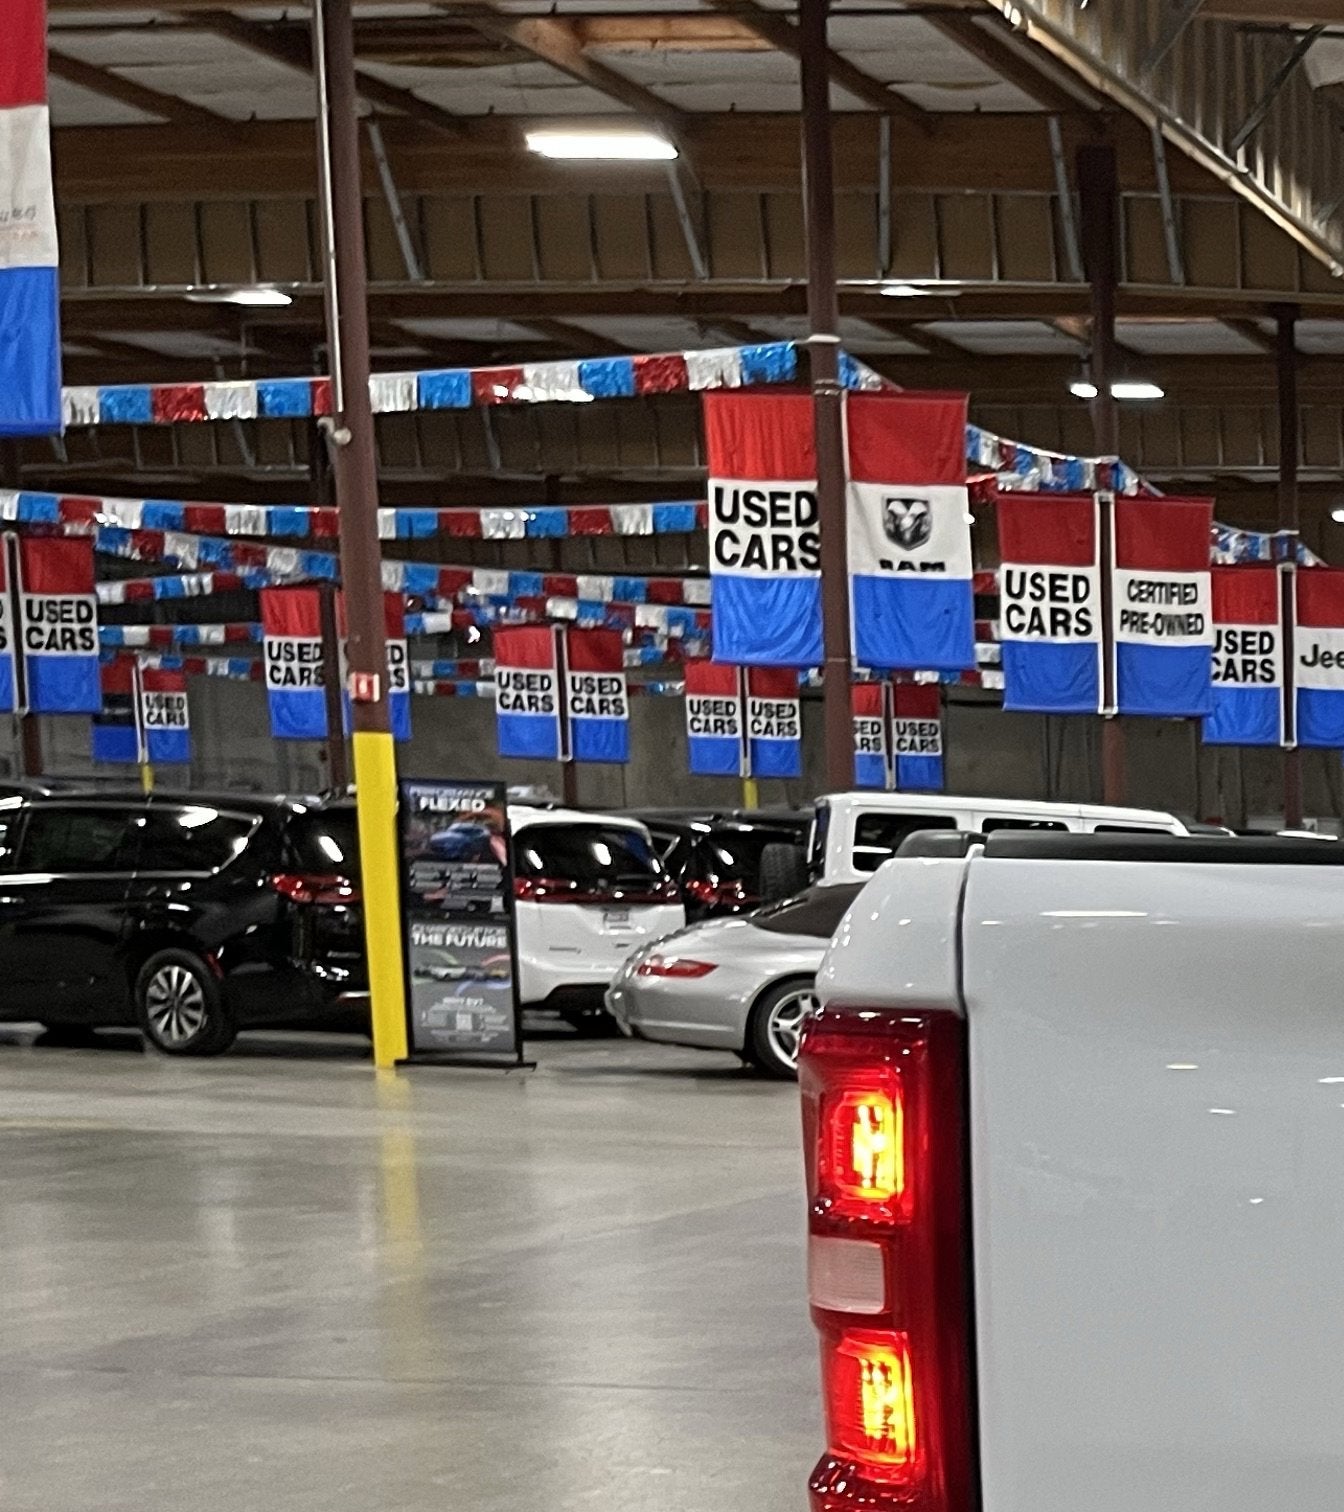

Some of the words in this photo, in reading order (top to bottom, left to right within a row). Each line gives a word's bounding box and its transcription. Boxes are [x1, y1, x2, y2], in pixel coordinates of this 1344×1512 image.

[715, 486, 818, 528] USED
[714, 529, 820, 571] CARS
[1006, 570, 1090, 604] USED
[1127, 579, 1198, 605] CERTIFIED
[25, 600, 93, 623] USED
[1006, 604, 1093, 637] CARS
[1120, 609, 1204, 636] PRE-OWNED
[25, 627, 95, 650] CARS
[498, 672, 552, 692] USED
[571, 676, 623, 695] USED
[499, 693, 554, 712] CARS
[571, 697, 625, 716] CARS
[689, 700, 737, 716] USED
[751, 701, 796, 719] USED
[690, 718, 738, 735] CARS
[751, 720, 797, 737] CARS
[896, 721, 938, 736] USED
[896, 738, 939, 753] CARS
[446, 933, 506, 949] FUTURE
